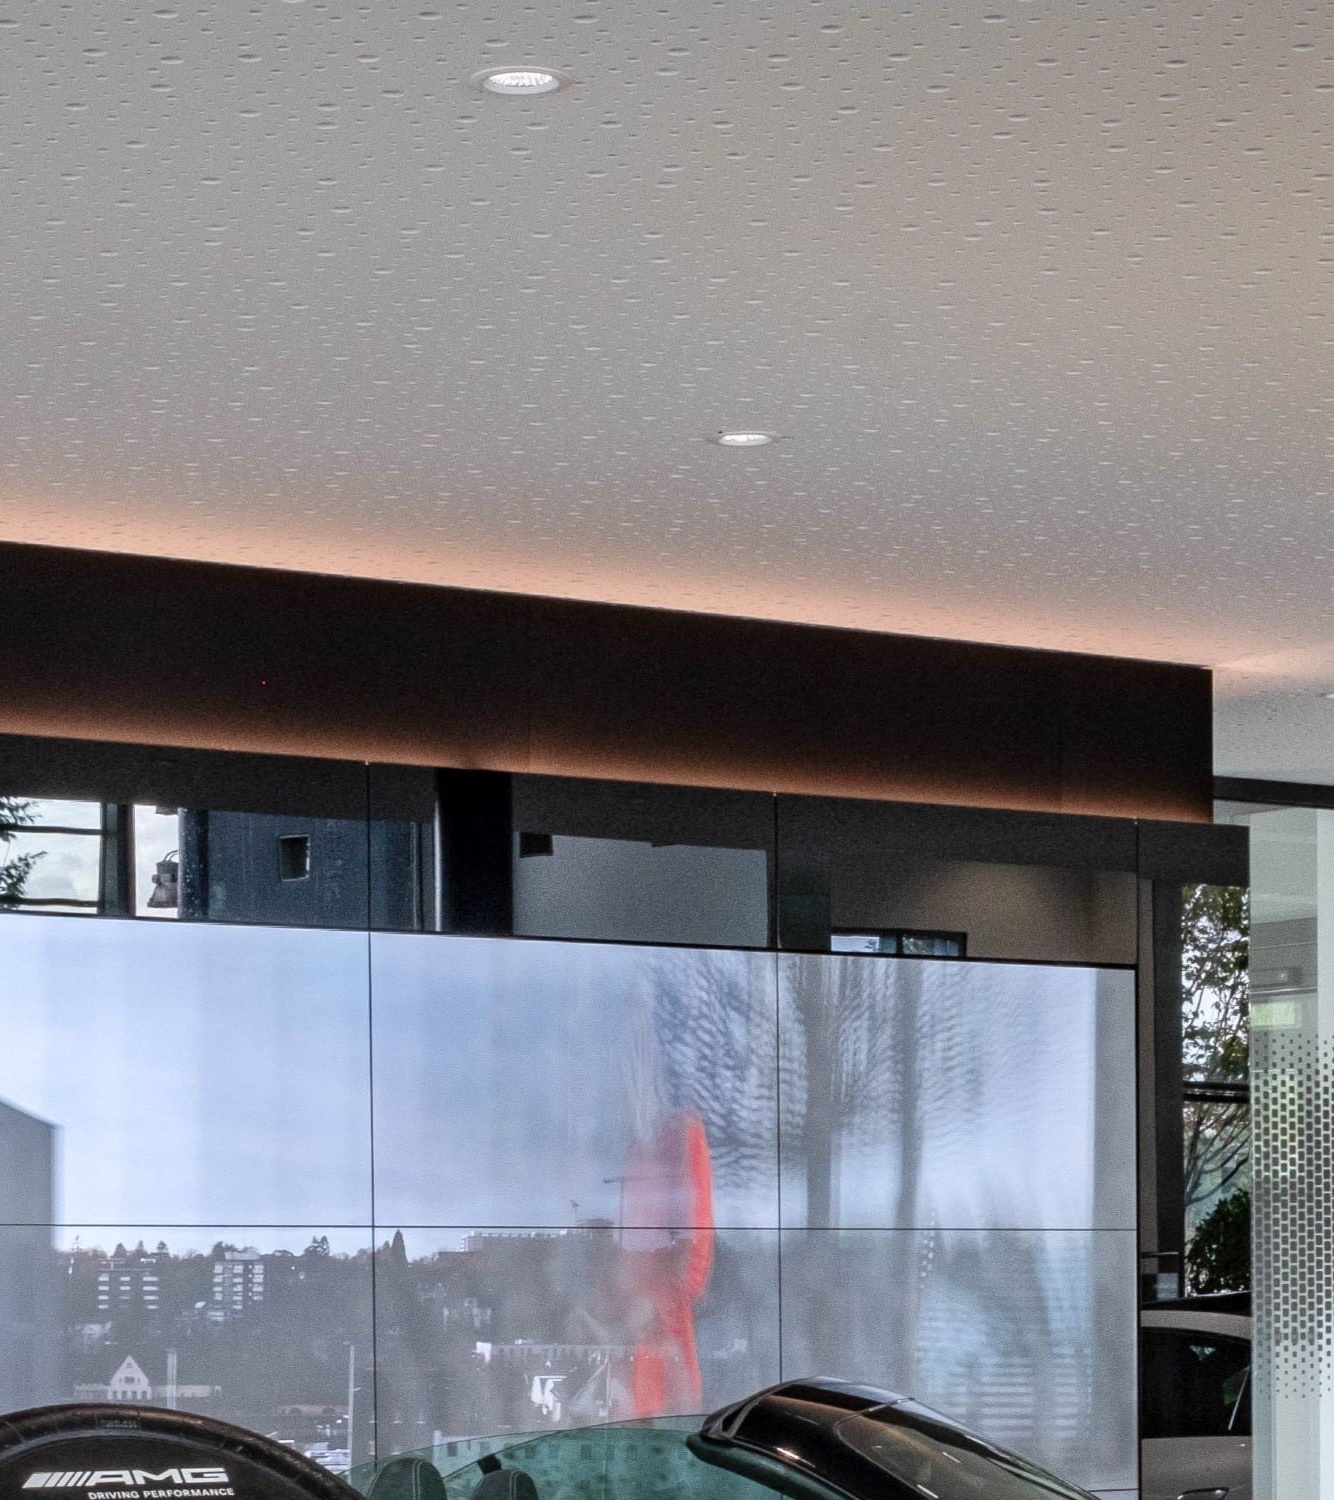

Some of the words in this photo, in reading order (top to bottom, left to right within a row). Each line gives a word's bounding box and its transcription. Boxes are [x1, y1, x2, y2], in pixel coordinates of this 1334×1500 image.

[84, 1467, 230, 1487] AMG
[88, 1489, 140, 1500] DRIVING
[144, 1487, 235, 1499] PERFORMANCE
